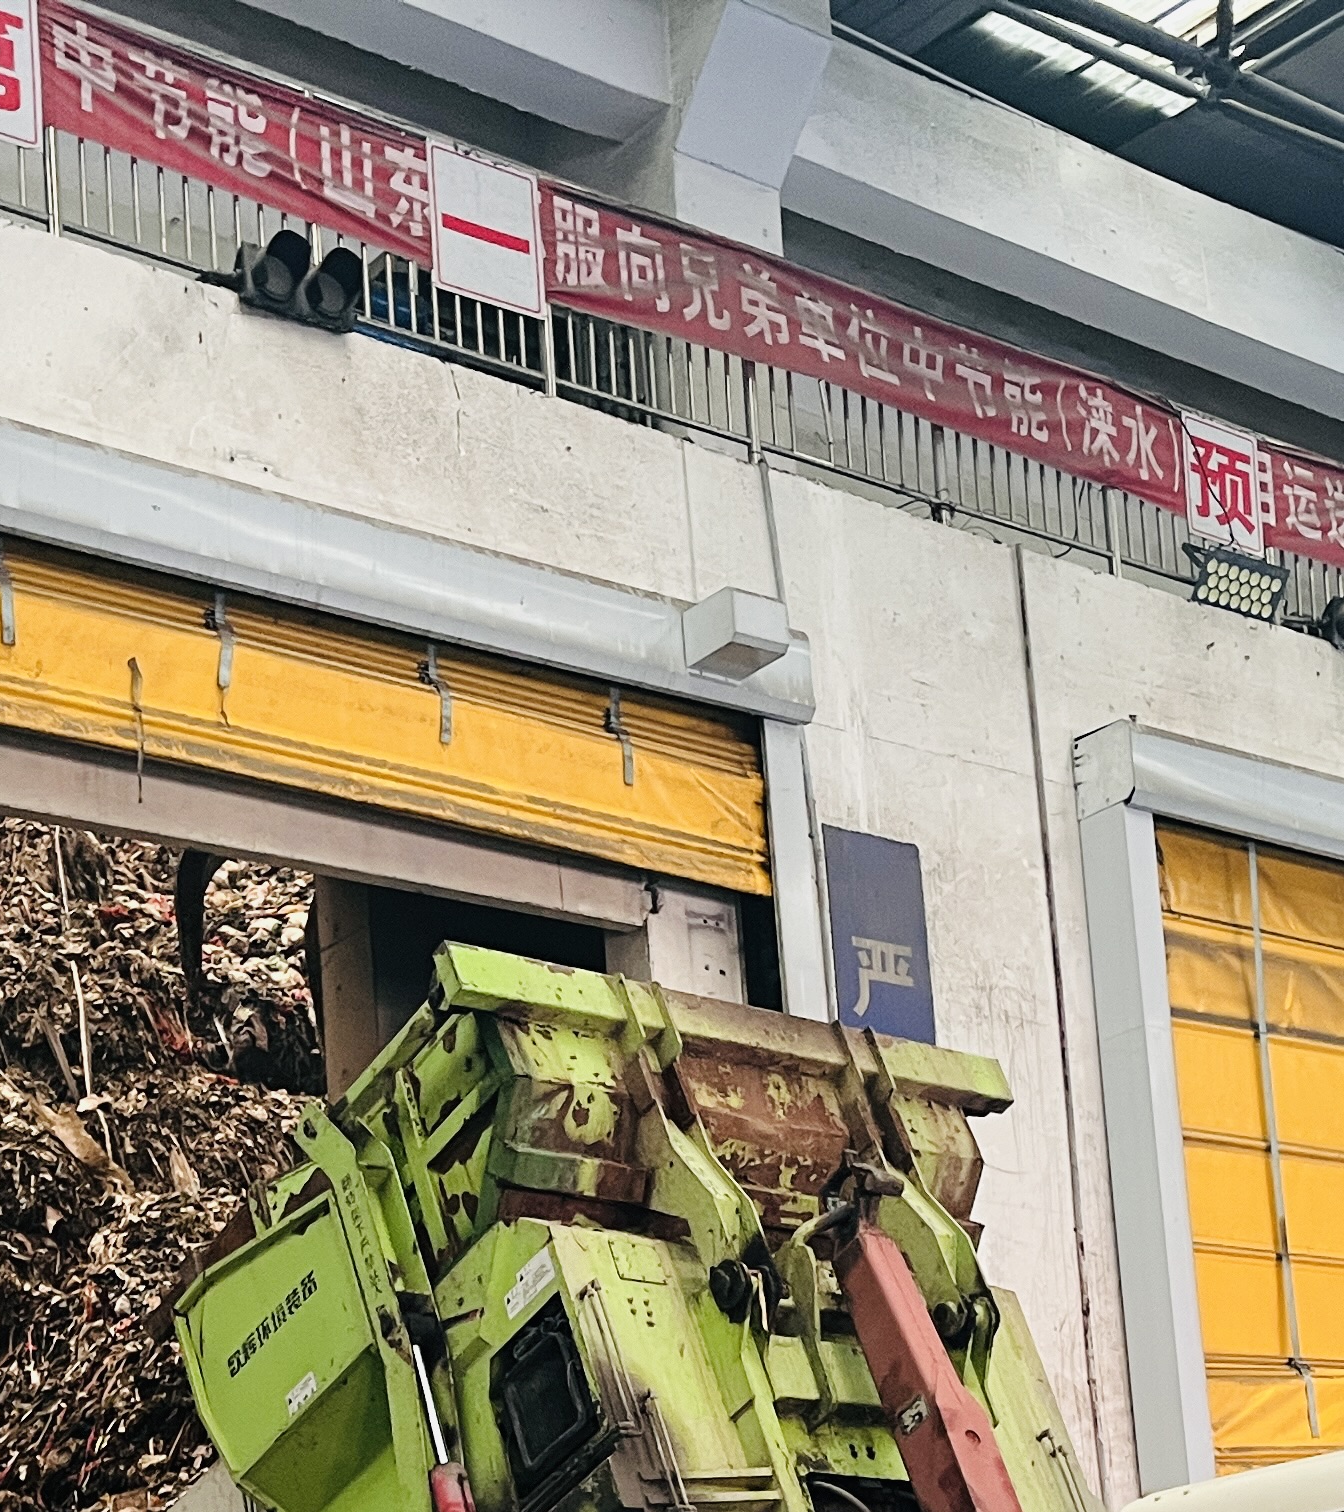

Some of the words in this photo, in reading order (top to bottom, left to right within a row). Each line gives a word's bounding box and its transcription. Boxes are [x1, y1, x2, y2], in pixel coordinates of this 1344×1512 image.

[441, 212, 531, 255] 一
[1190, 435, 1255, 535] 预
[851, 935, 914, 1017] 严
